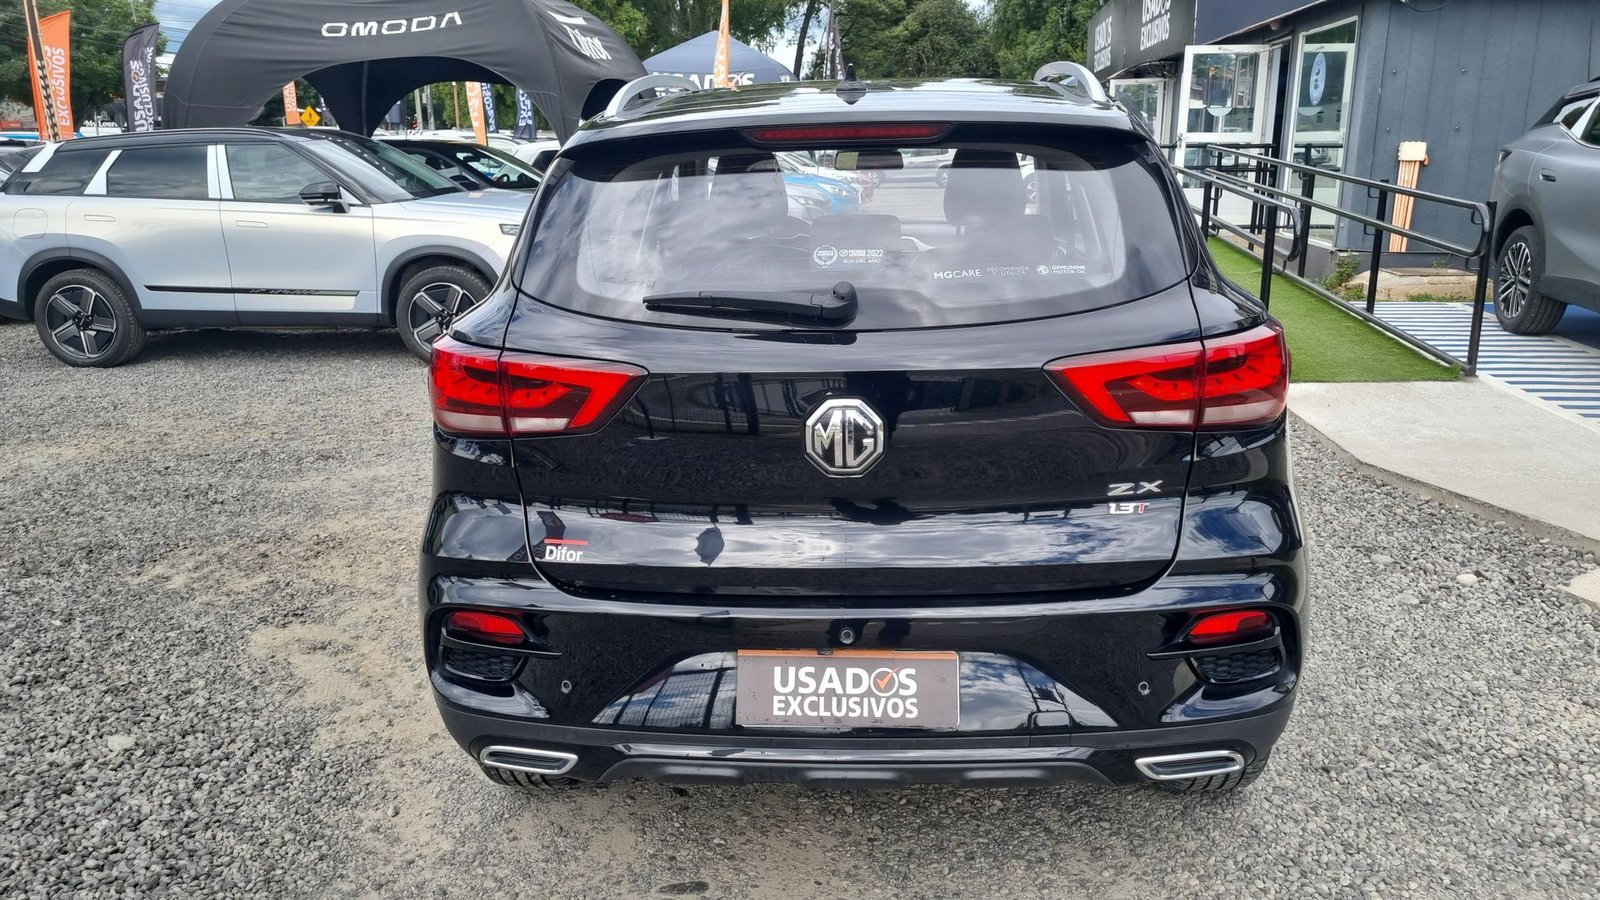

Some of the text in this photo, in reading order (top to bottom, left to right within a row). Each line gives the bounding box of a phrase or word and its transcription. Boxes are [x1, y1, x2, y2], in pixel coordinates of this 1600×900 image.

[321, 12, 463, 37] OMODA
[1140, 12, 1171, 51] EXCLUSIVOS
[129, 60, 148, 132] USADOS
[867, 249, 884, 257] 2022
[934, 268, 982, 280] MGCARE
[812, 406, 877, 469] MG
[545, 545, 584, 562] Difor
[773, 665, 918, 697] USADOS
[772, 695, 919, 719] EXCLUSIVOS
